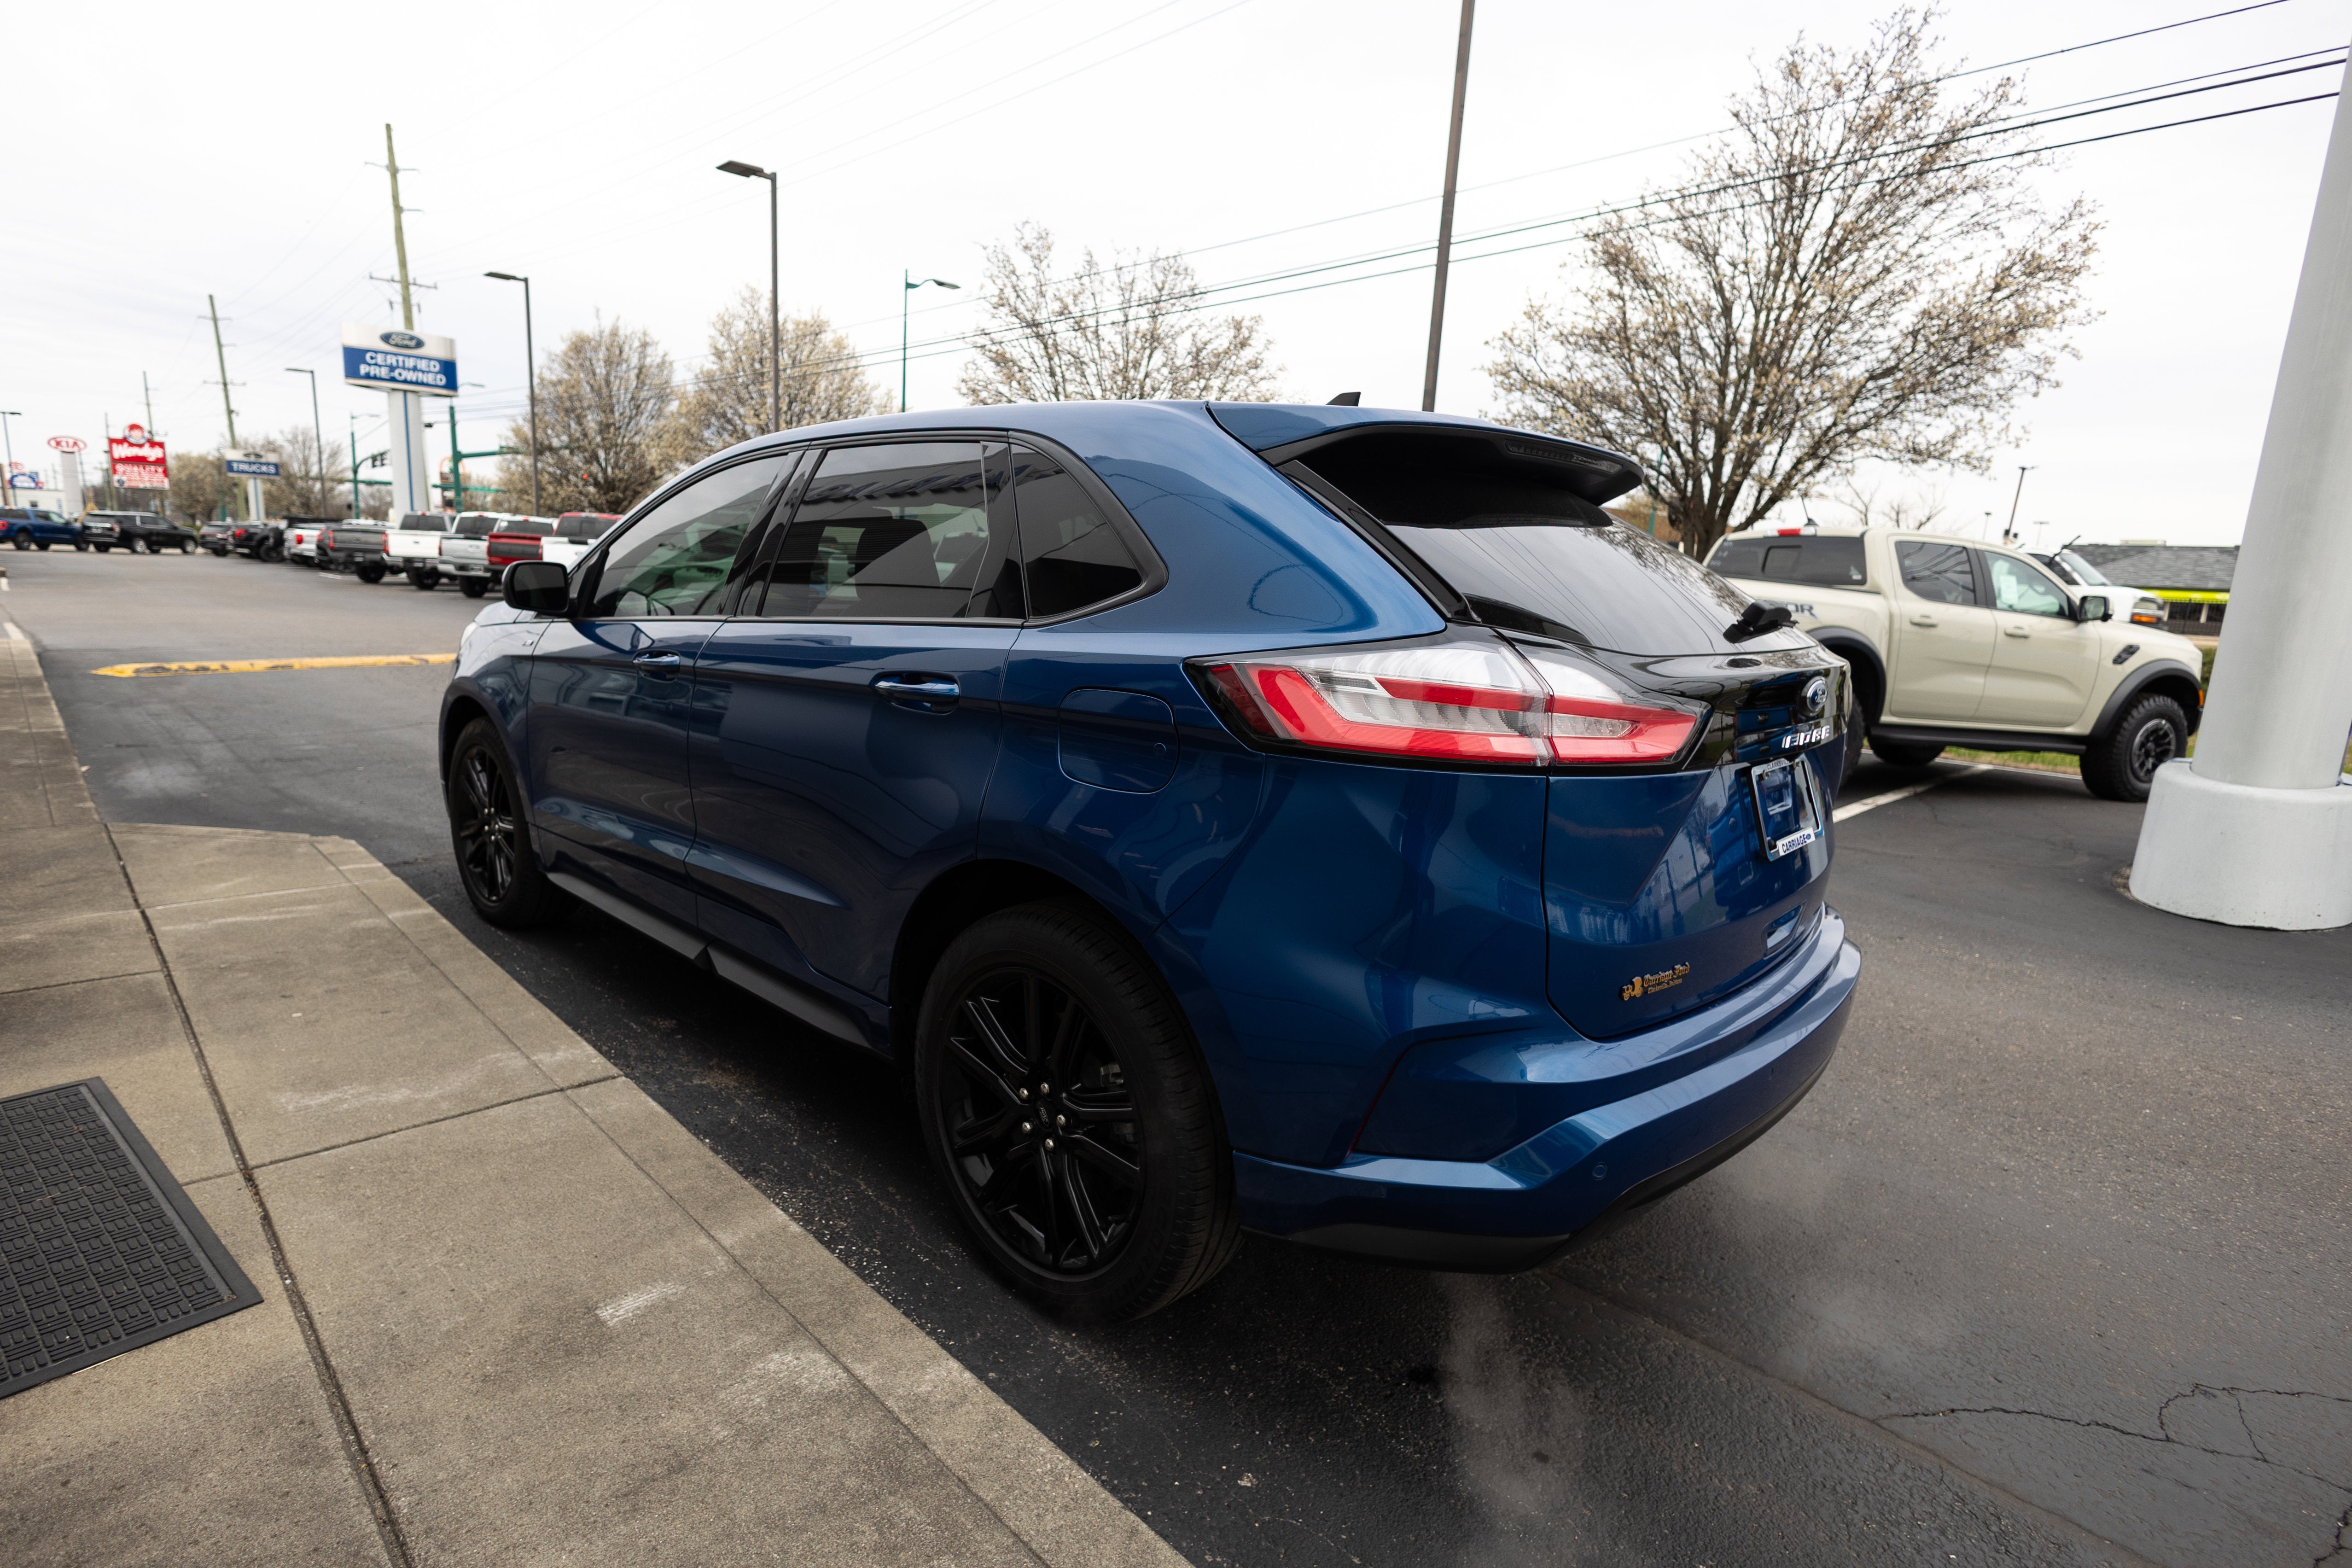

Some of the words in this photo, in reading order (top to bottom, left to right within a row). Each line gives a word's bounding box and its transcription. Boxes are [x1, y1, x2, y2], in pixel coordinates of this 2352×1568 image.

[389, 332, 417, 348] Ford
[365, 351, 440, 372] CERTIFIED
[359, 364, 446, 386] PRE-OWNED
[54, 439, 80, 448] KIA
[111, 442, 164, 461] Wendy's
[231, 462, 276, 474] TRUCKS
[1781, 725, 1830, 748] EDGE
[1782, 834, 1807, 853] CARRIAGE
